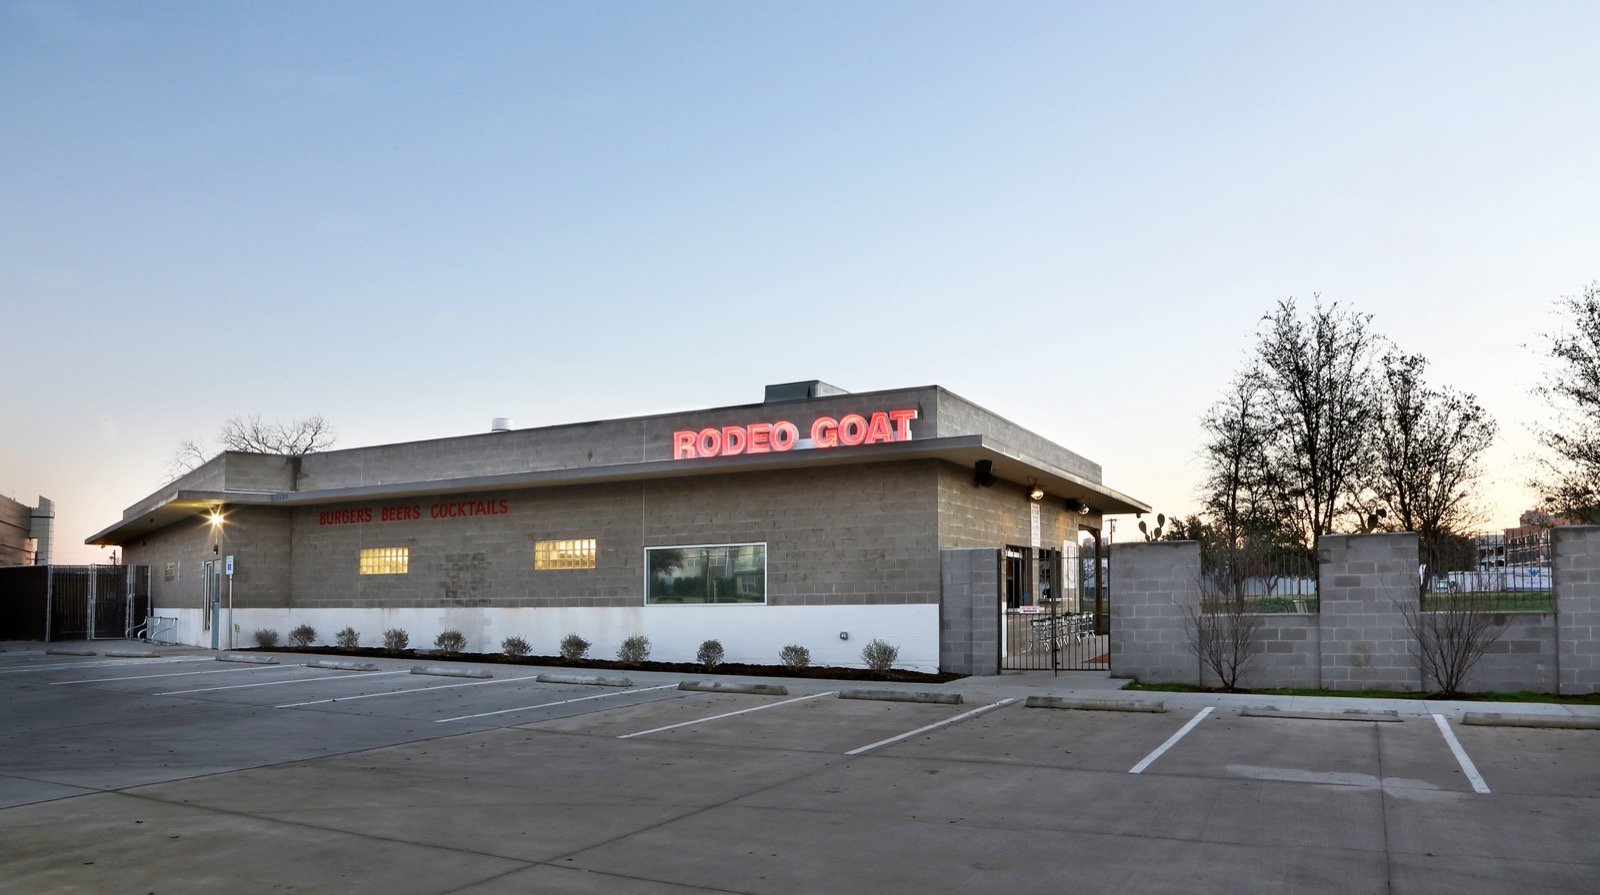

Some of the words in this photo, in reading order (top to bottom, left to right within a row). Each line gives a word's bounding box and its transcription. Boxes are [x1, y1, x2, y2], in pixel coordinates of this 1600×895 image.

[673, 420, 798, 461] RODEO
[810, 409, 918, 448] GOAT
[319, 508, 373, 526] BURGERS
[381, 504, 421, 522] BEERS
[430, 499, 508, 519] COCKTAILS
